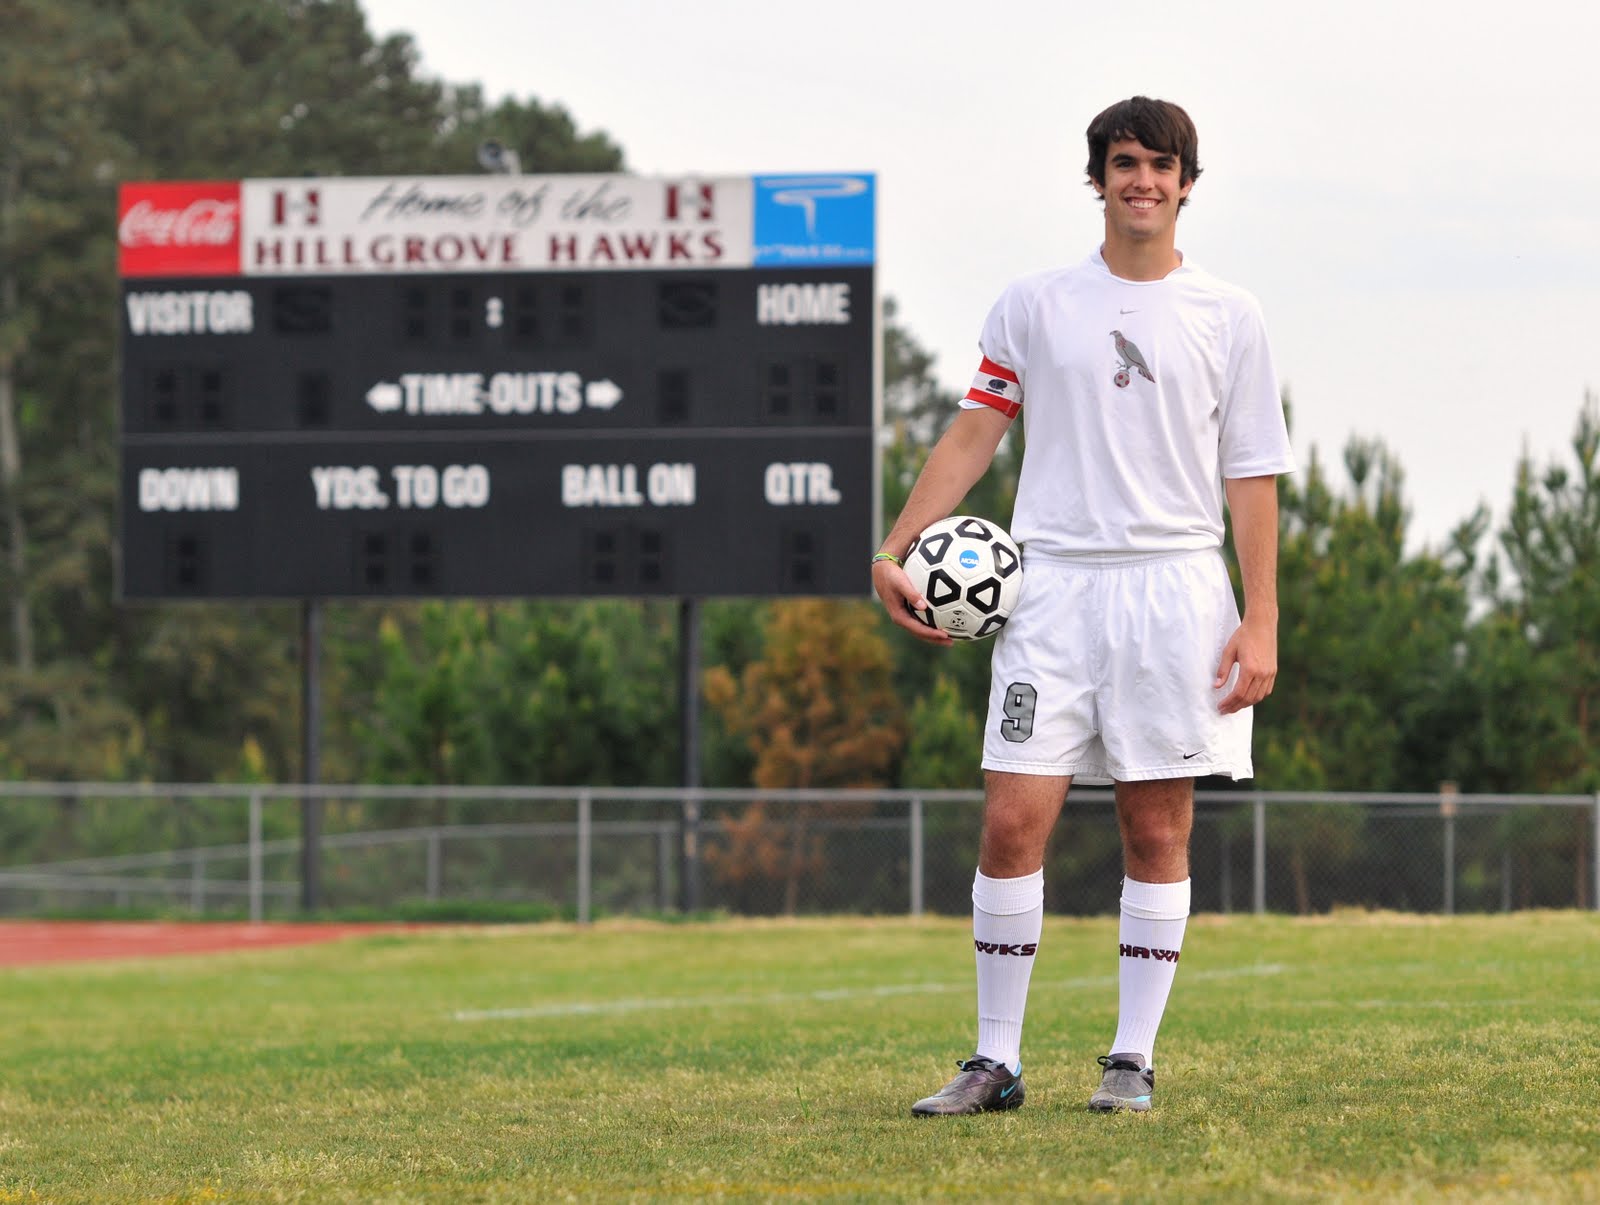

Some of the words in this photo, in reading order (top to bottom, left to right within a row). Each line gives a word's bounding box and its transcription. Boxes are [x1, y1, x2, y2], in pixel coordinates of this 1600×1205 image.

[359, 181, 487, 223] Home
[497, 183, 551, 230] of
[560, 181, 633, 221] the
[255, 234, 521, 266] HILLGROVE
[549, 230, 725, 262] HAWKS
[127, 291, 253, 335] VISITOR
[757, 283, 850, 324] HOME
[401, 373, 582, 415] TIME-OUTS
[138, 467, 239, 512] DOWN
[311, 465, 390, 510] YDS.
[392, 464, 438, 509] TO
[441, 464, 490, 508] GO
[561, 463, 644, 507] BALL
[647, 463, 696, 505] ON
[764, 462, 842, 505] QTR.
[1000, 681, 1037, 743] 9
[975, 940, 1037, 956] WKS
